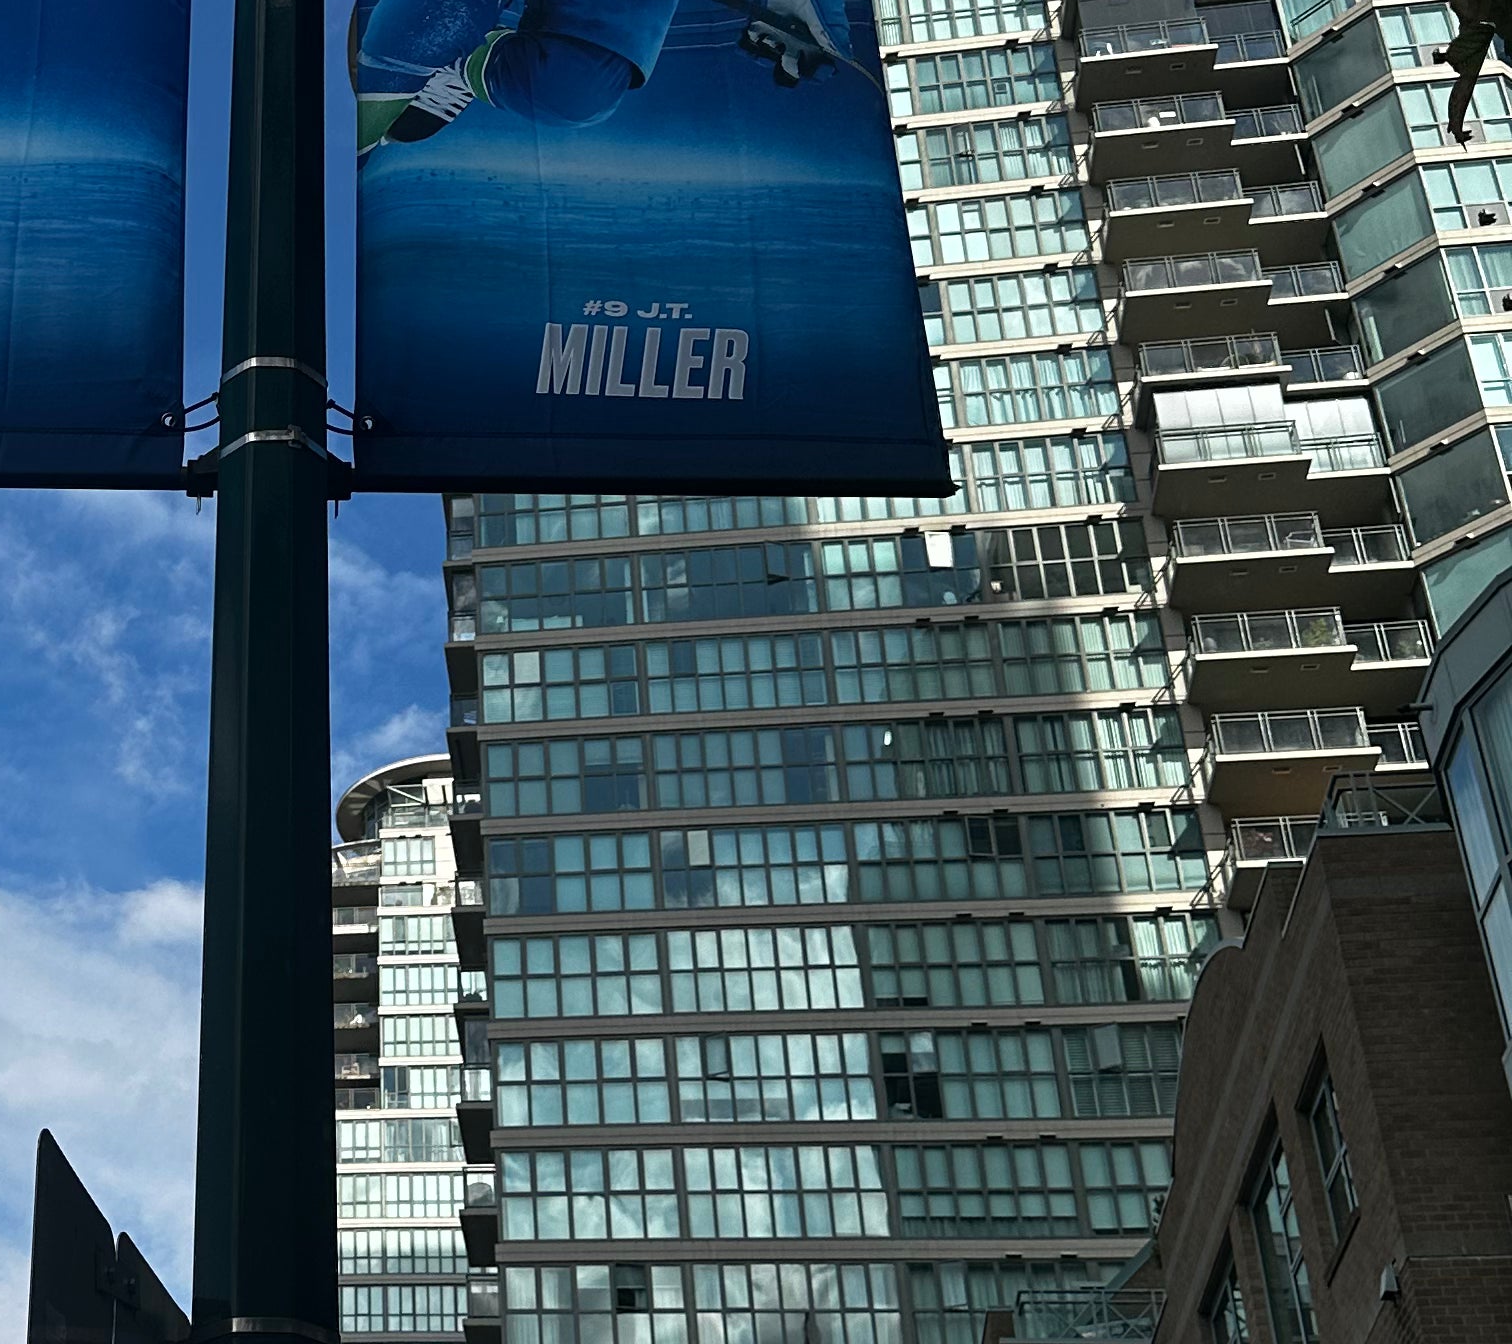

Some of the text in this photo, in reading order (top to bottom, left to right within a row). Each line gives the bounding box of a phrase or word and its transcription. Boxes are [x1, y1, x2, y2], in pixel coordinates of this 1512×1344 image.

[582, 299, 693, 319] #9 J.T.
[536, 322, 750, 400] MILLER
